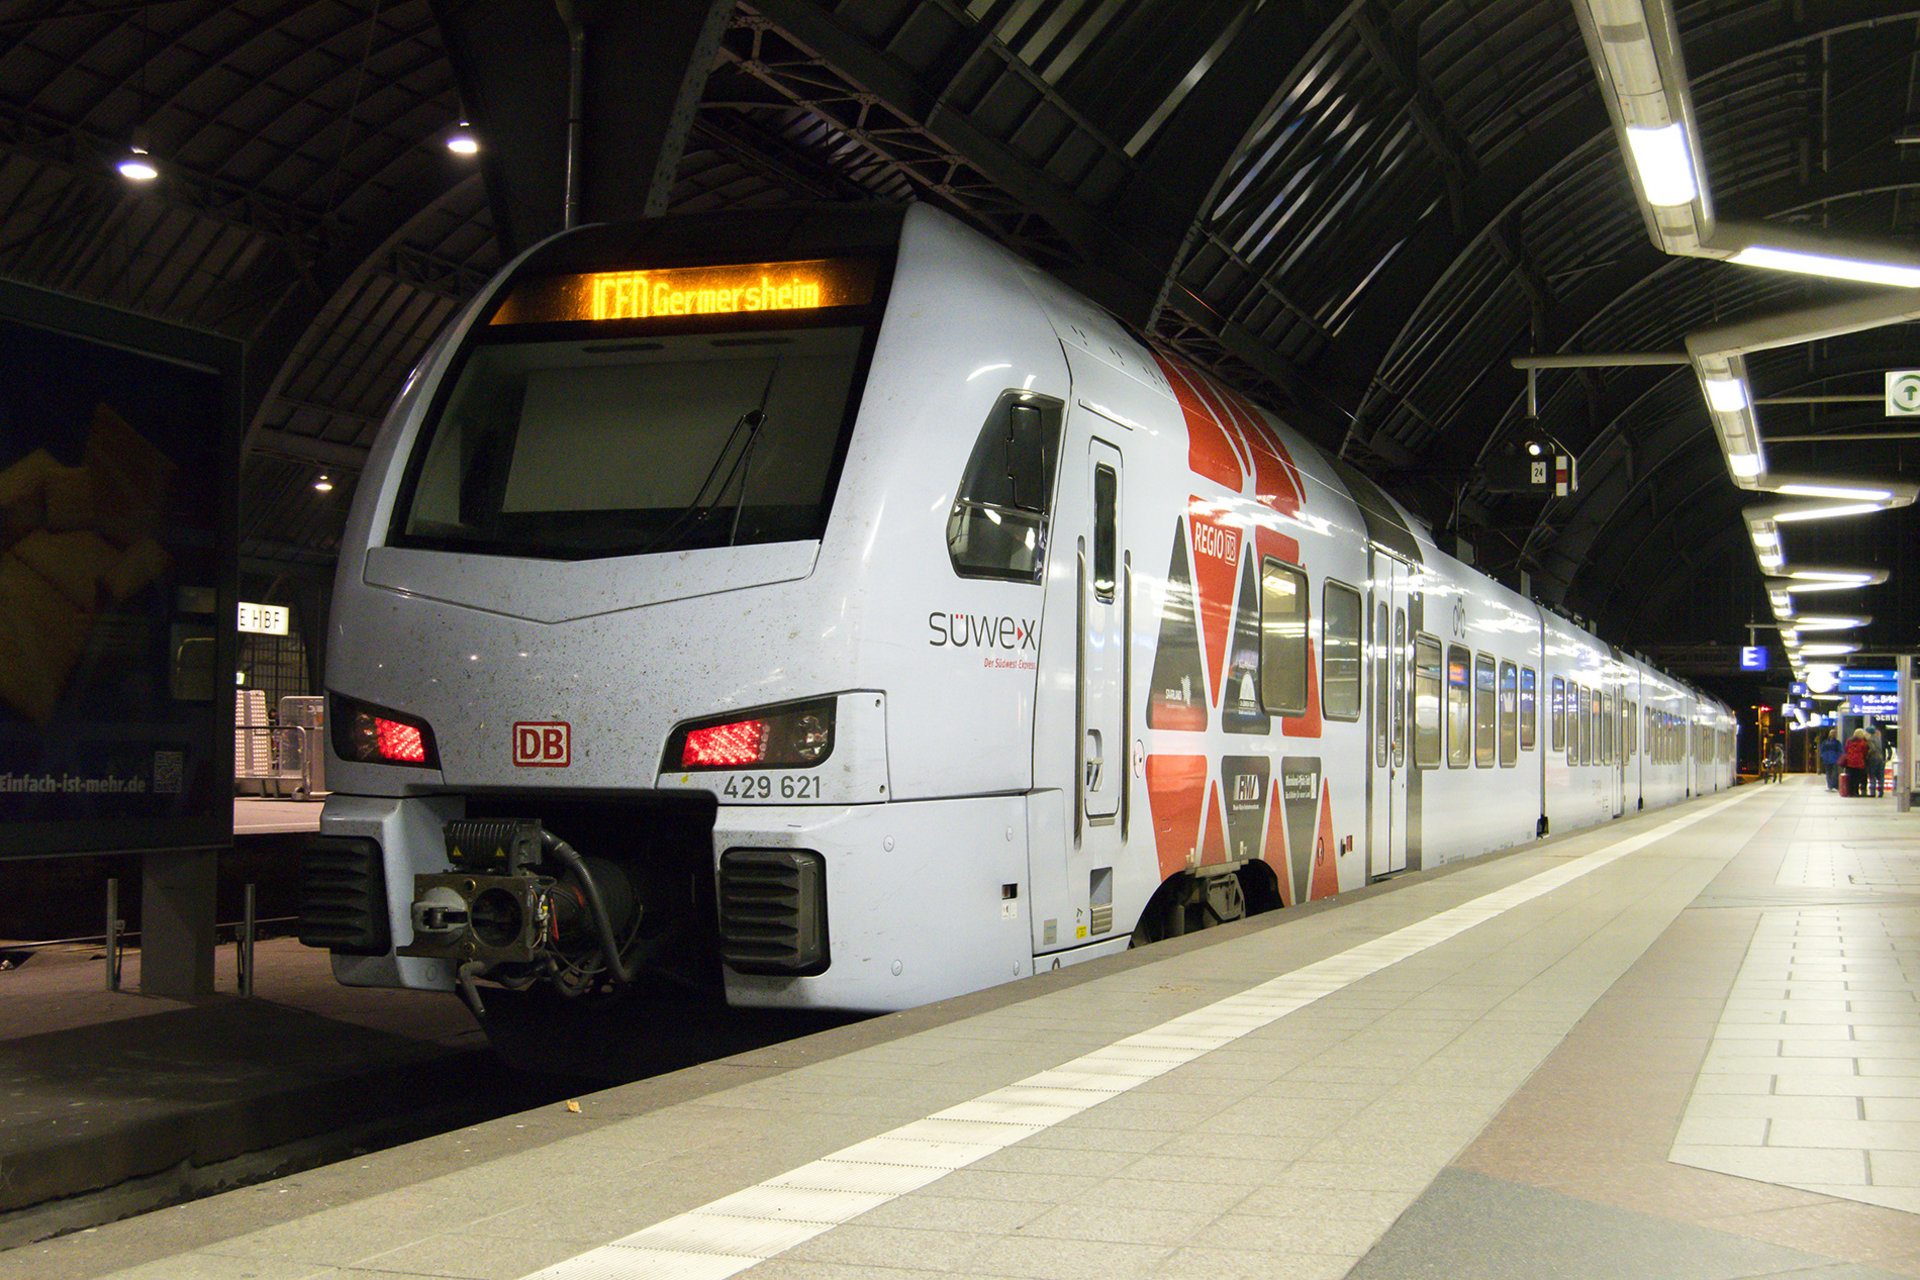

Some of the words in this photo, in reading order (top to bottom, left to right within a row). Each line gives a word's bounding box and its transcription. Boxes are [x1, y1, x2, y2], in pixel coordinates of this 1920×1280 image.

[653, 276, 819, 316] Germersheim
[1533, 467, 1544, 478] 24
[1194, 521, 1224, 559] REGIO
[1225, 532, 1237, 563] DB
[253, 610, 280, 630] HBF
[1742, 646, 1759, 666] E
[517, 727, 566, 762] DB
[0, 771, 147, 793] Einfach-ist-mehr.de
[722, 775, 771, 799] 429
[780, 774, 821, 799] 621
